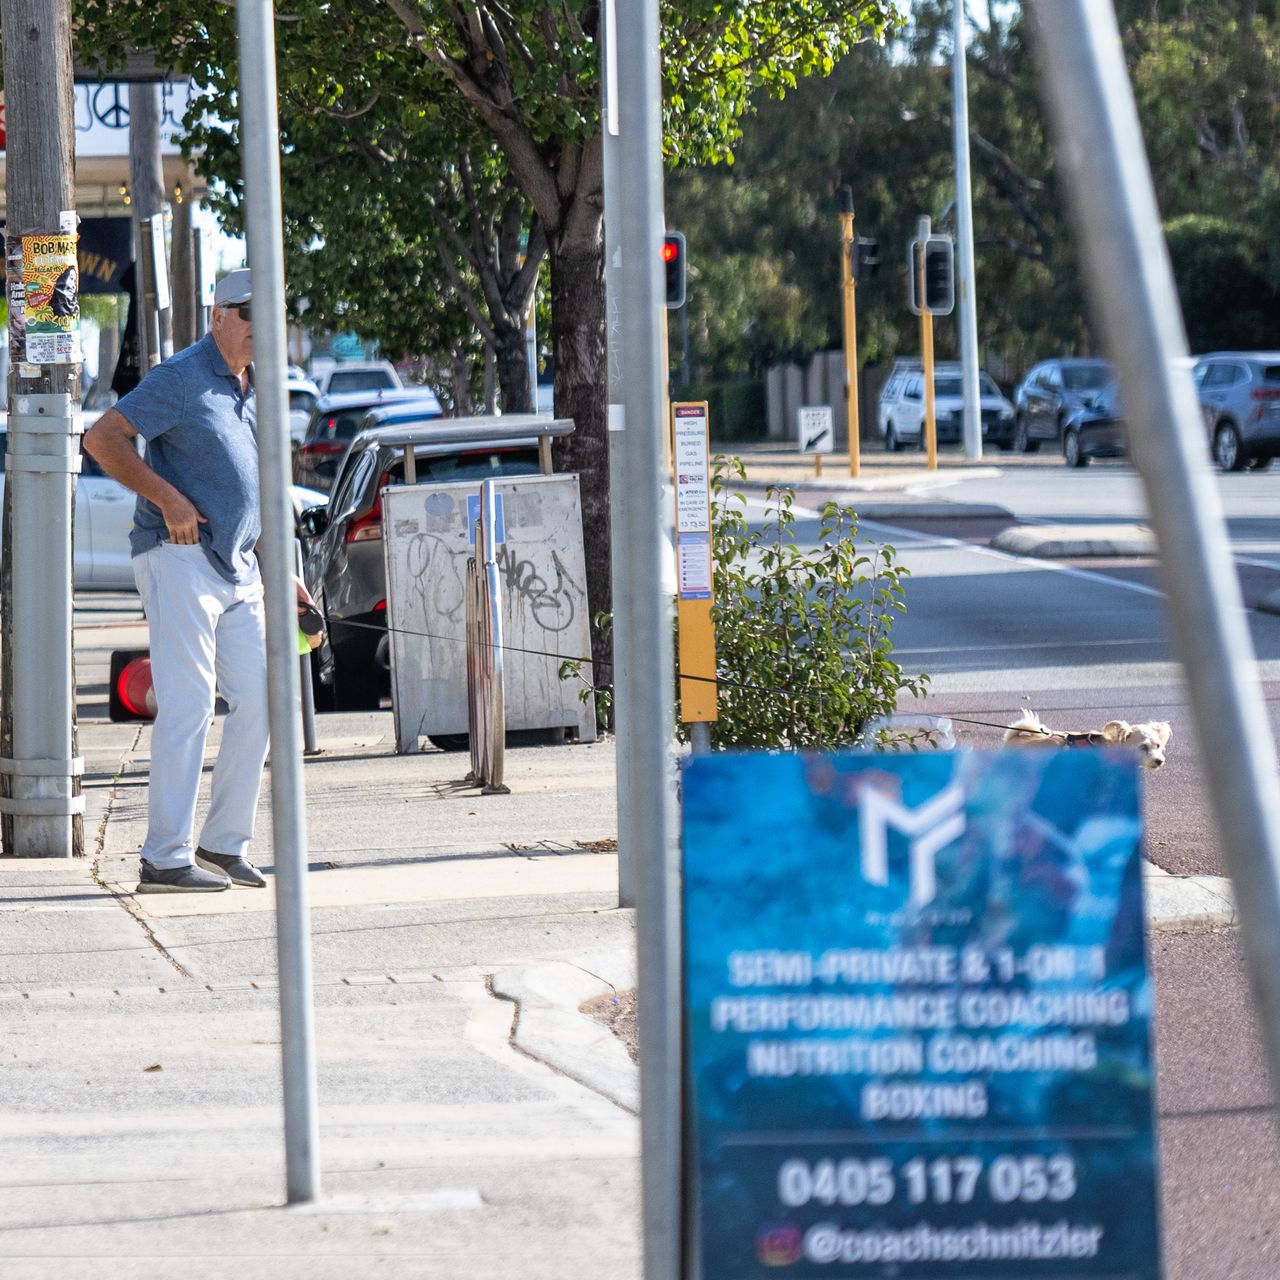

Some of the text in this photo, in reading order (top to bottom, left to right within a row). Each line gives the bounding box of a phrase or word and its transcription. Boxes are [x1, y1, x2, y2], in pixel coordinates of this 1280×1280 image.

[33, 242, 55, 255] BOB
[728, 946, 958, 987] SEMI-PRIVATE
[711, 990, 1130, 1032] PERFORMANCE COACHING
[747, 1032, 1098, 1077] NUTRITION COACHING
[861, 1080, 990, 1120] BOXING
[778, 1154, 1078, 1207] 0405 117 053
